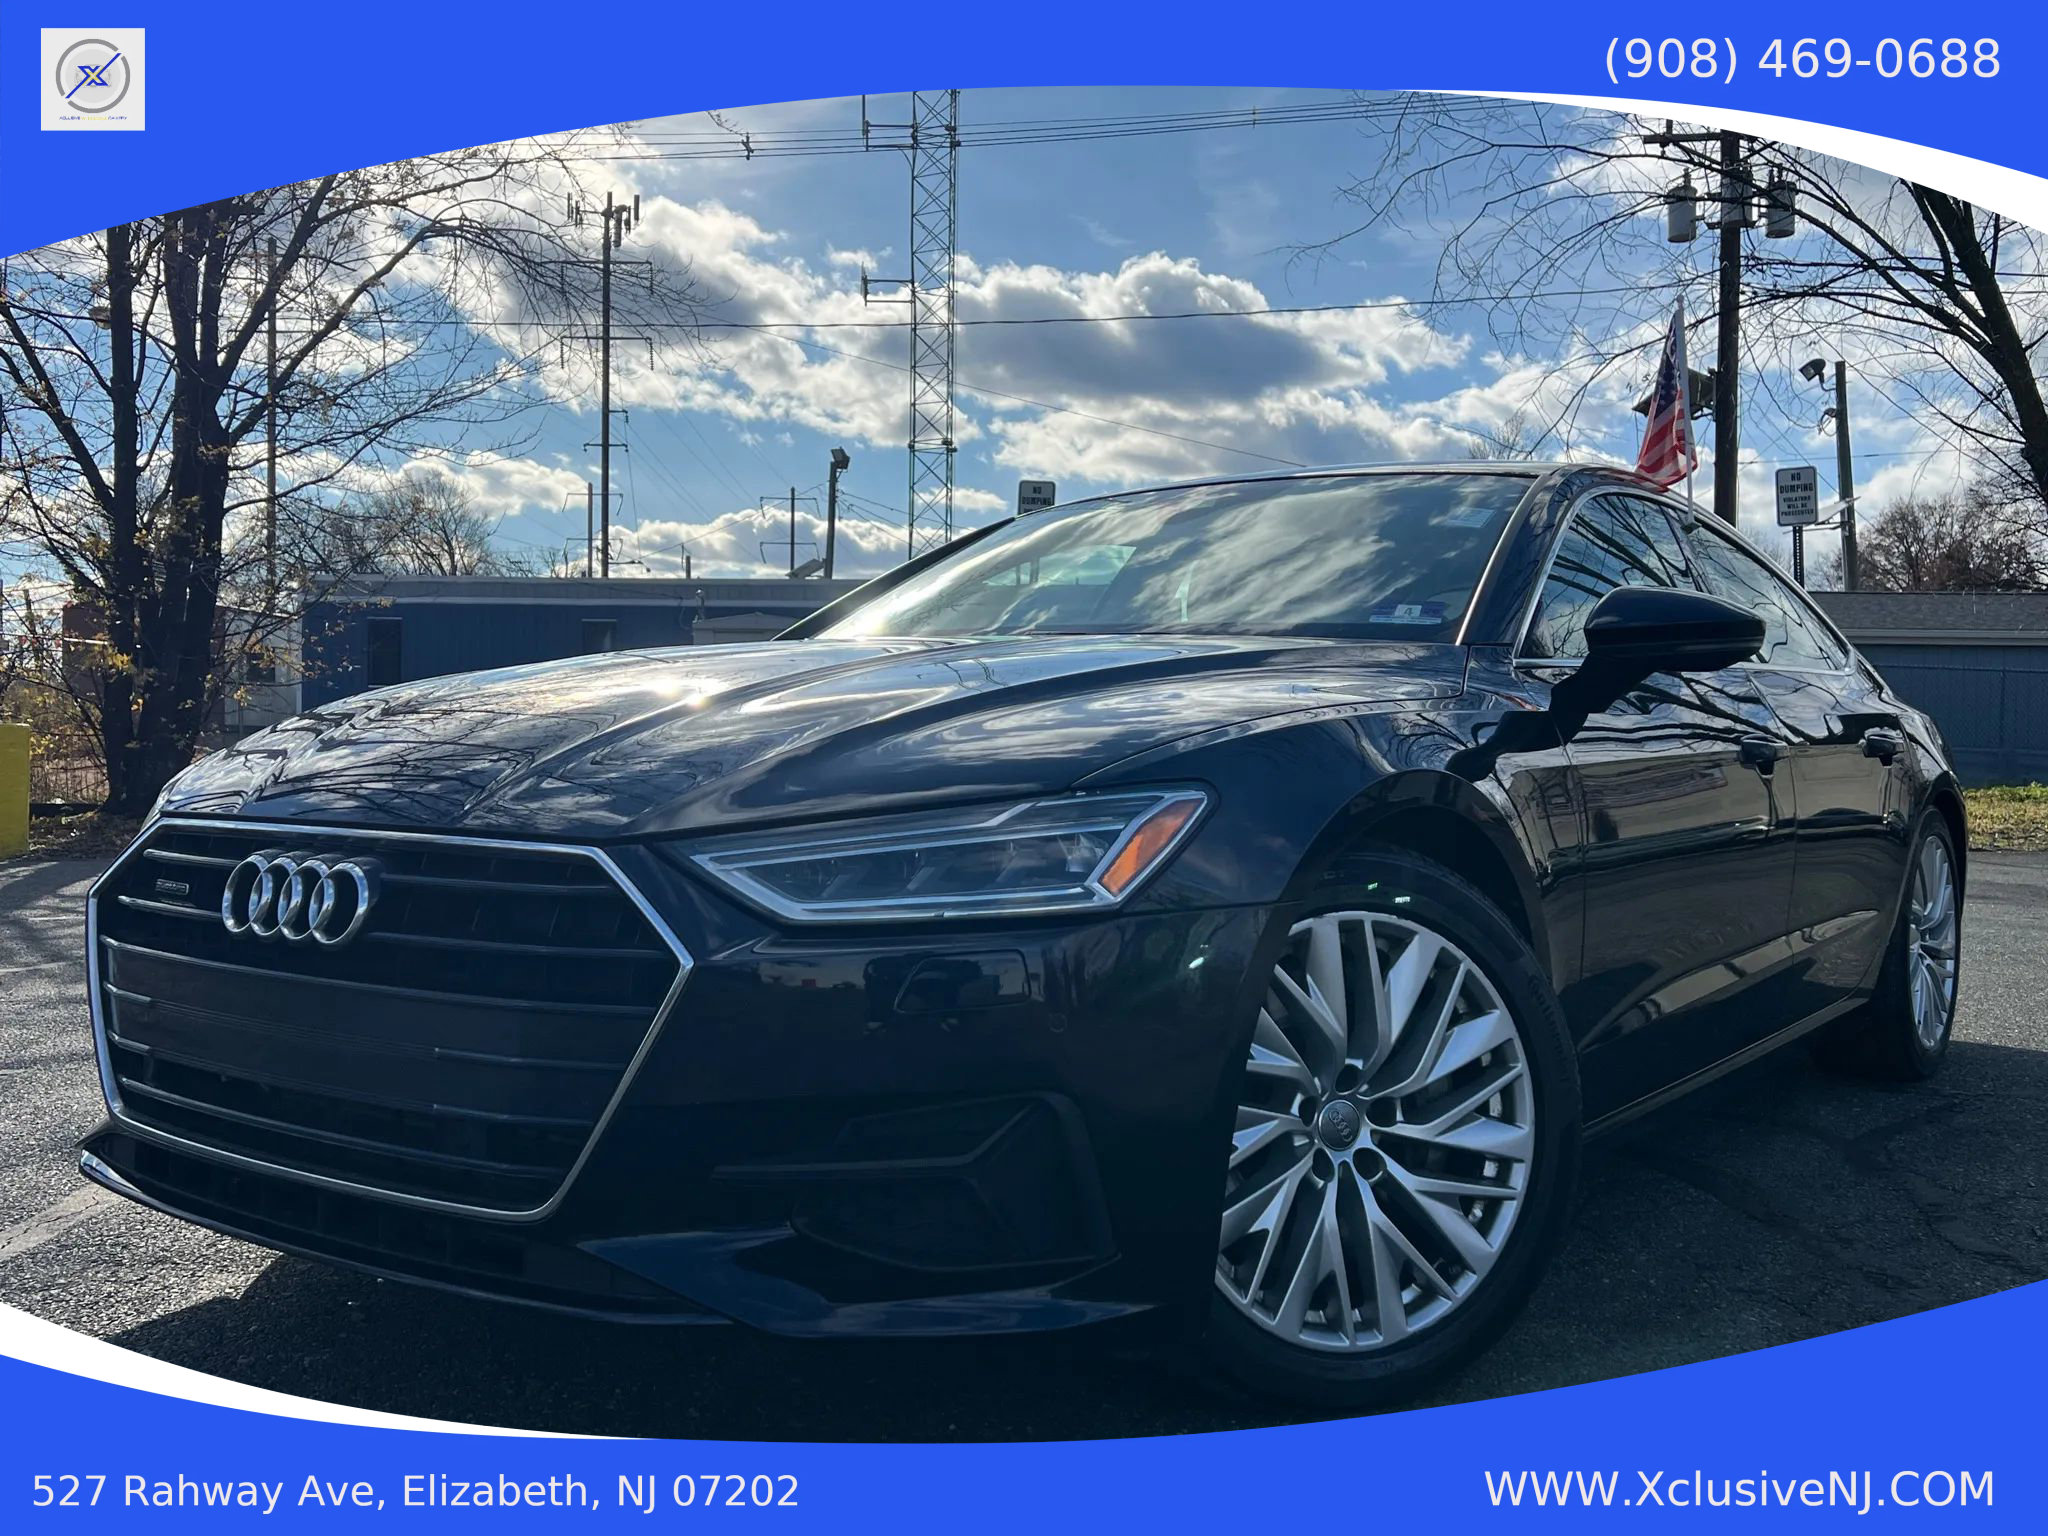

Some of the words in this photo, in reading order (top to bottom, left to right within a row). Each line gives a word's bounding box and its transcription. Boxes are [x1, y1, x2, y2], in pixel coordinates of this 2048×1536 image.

[1791, 472, 1801, 481] NO
[1779, 482, 1814, 494] DUMPING
[1404, 607, 1413, 616] 4
